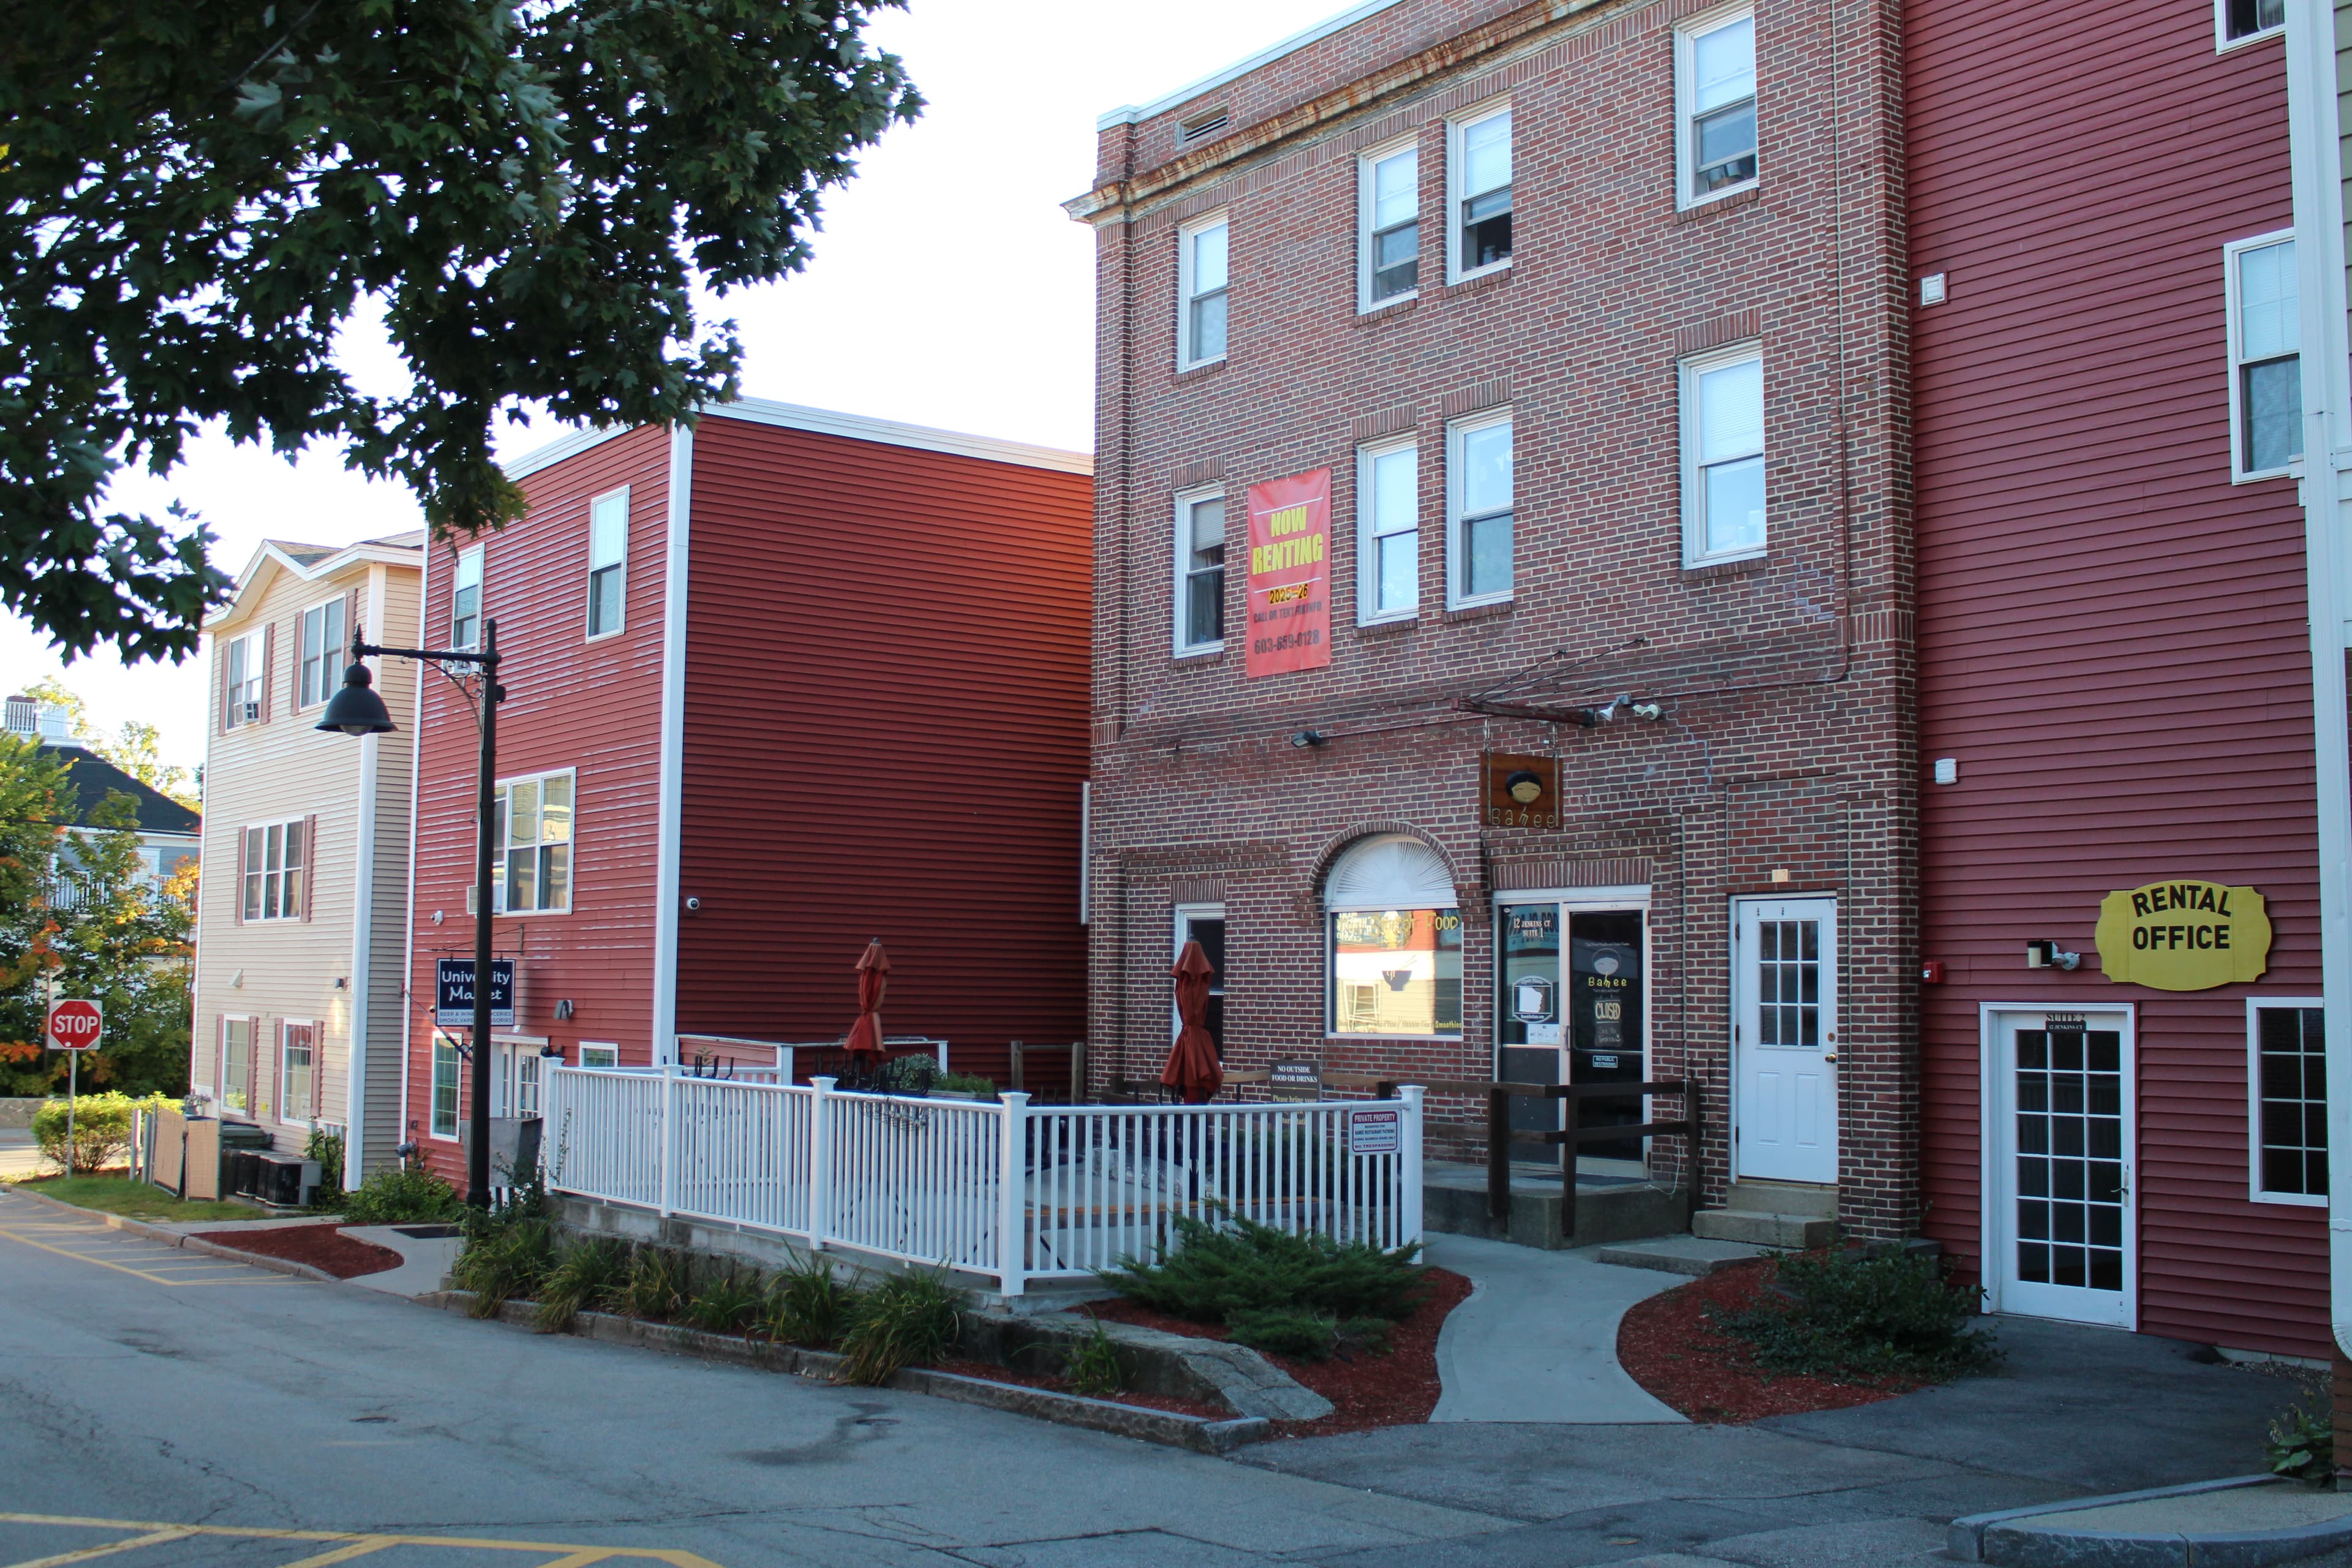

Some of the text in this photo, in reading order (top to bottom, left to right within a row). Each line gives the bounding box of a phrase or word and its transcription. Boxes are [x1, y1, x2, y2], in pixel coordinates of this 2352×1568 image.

[1271, 506, 1307, 537] NOW
[1253, 533, 1323, 575] RENTING
[1254, 612, 1267, 623] CALL
[1269, 610, 1278, 620] OR
[1280, 607, 1294, 619] TEXT
[1254, 629, 1320, 654] 603-659-0128
[2132, 884, 2232, 918] RENTAL
[1513, 918, 1521, 929] 12
[2133, 925, 2230, 950] OFFICE
[442, 971, 510, 985] Univity
[449, 986, 502, 1001] Maet
[54, 1015, 99, 1034] STOP
[2046, 1013, 2076, 1022] SUITE
